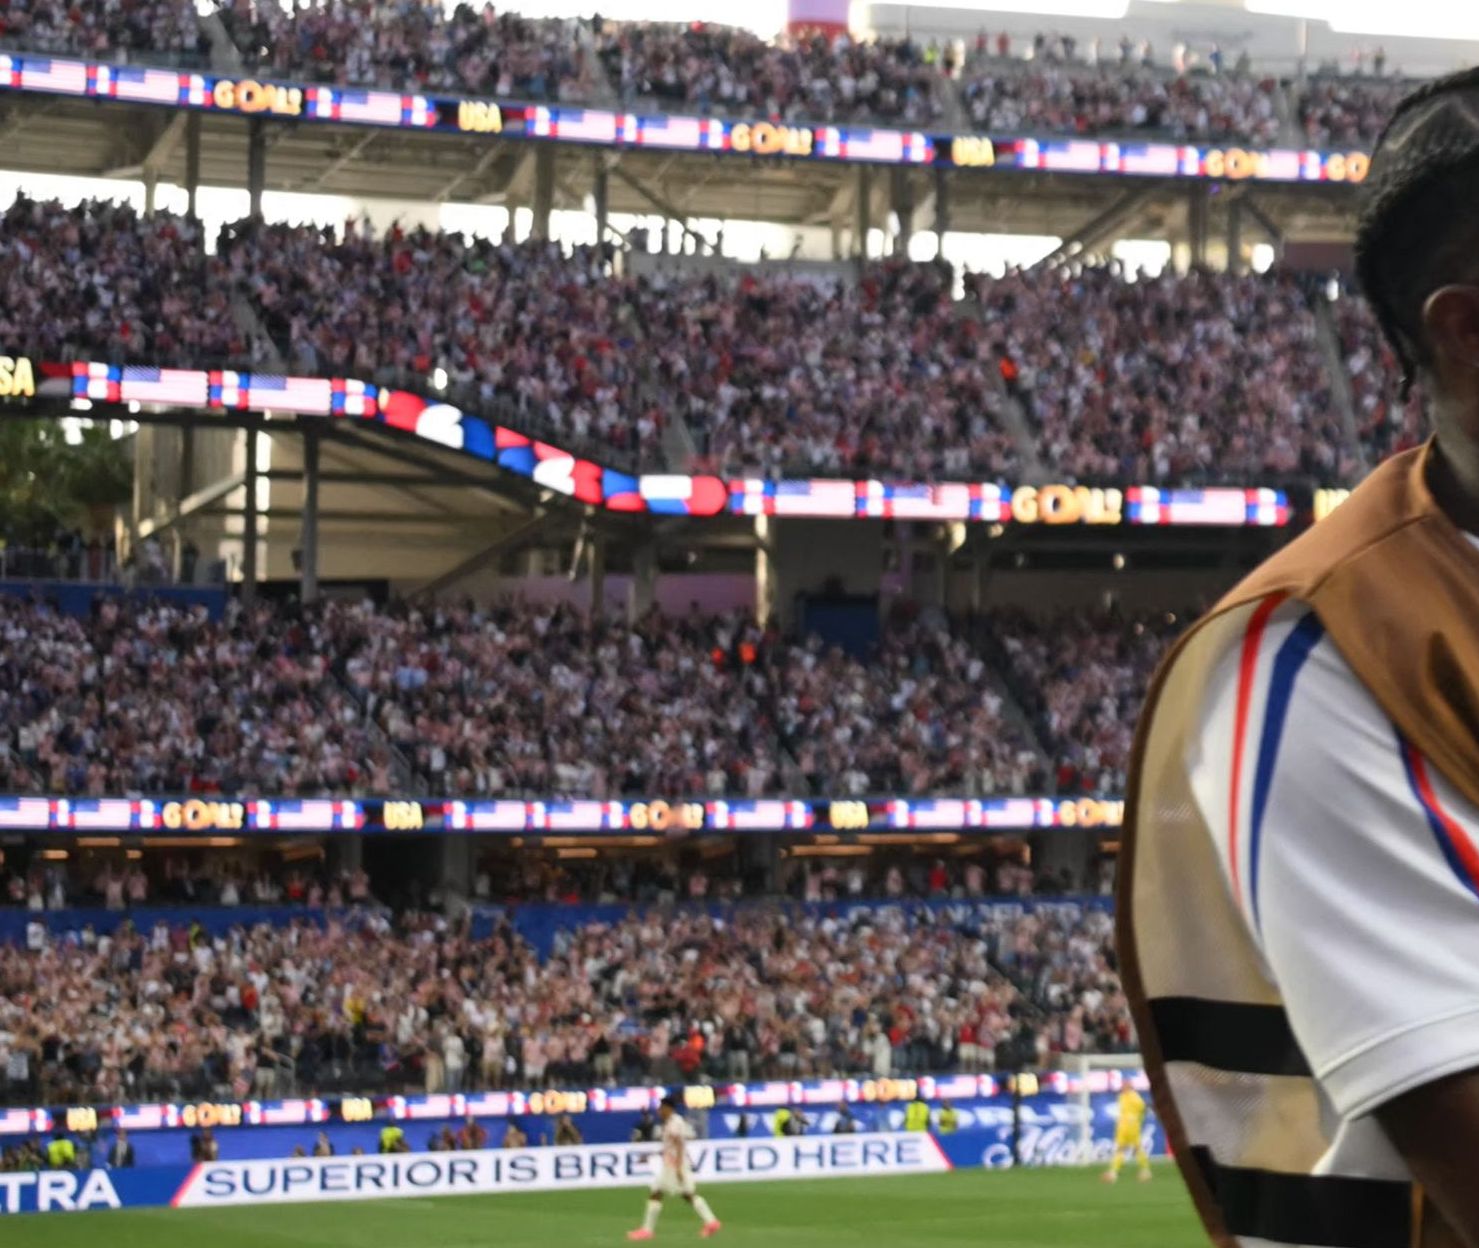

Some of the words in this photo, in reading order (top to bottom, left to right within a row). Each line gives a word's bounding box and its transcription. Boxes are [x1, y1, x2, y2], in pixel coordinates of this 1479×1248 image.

[459, 101, 502, 132] USA
[0, 356, 35, 397] SA
[205, 1157, 480, 1197] SUPERIOR
[495, 1154, 538, 1184] IS
[794, 1137, 923, 1170] HERE
[0, 1168, 122, 1213] TRA
